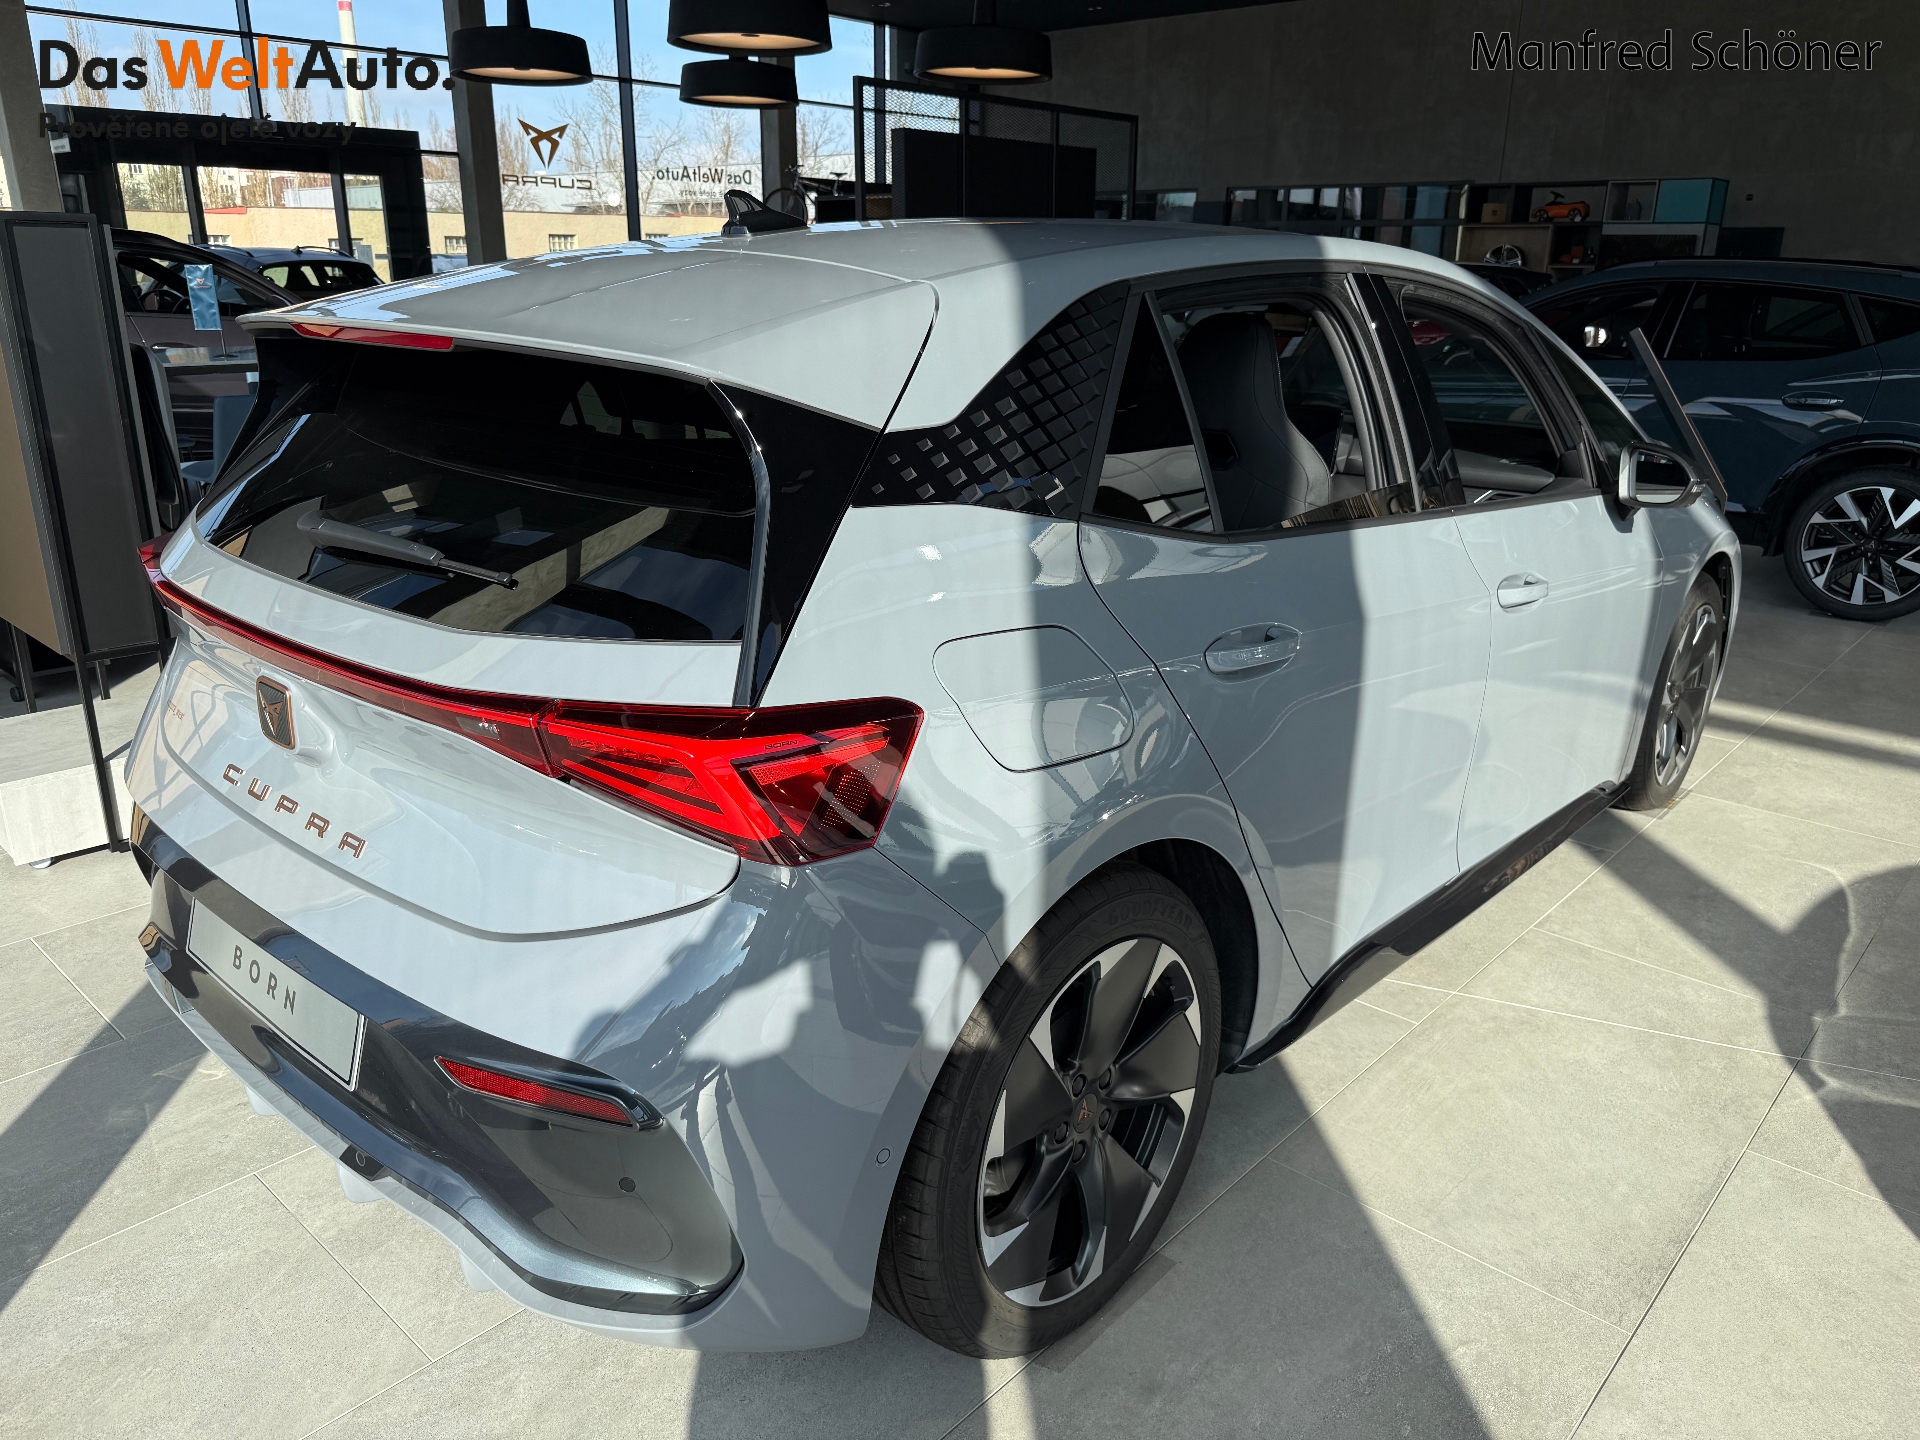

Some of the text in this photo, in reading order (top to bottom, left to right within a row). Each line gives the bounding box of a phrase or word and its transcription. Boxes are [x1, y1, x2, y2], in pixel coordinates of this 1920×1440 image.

[764, 740, 798, 749] BORN
[223, 763, 368, 859] CUPRA
[1107, 898, 1193, 931] GOODYEAR
[232, 944, 297, 1016] BORN
